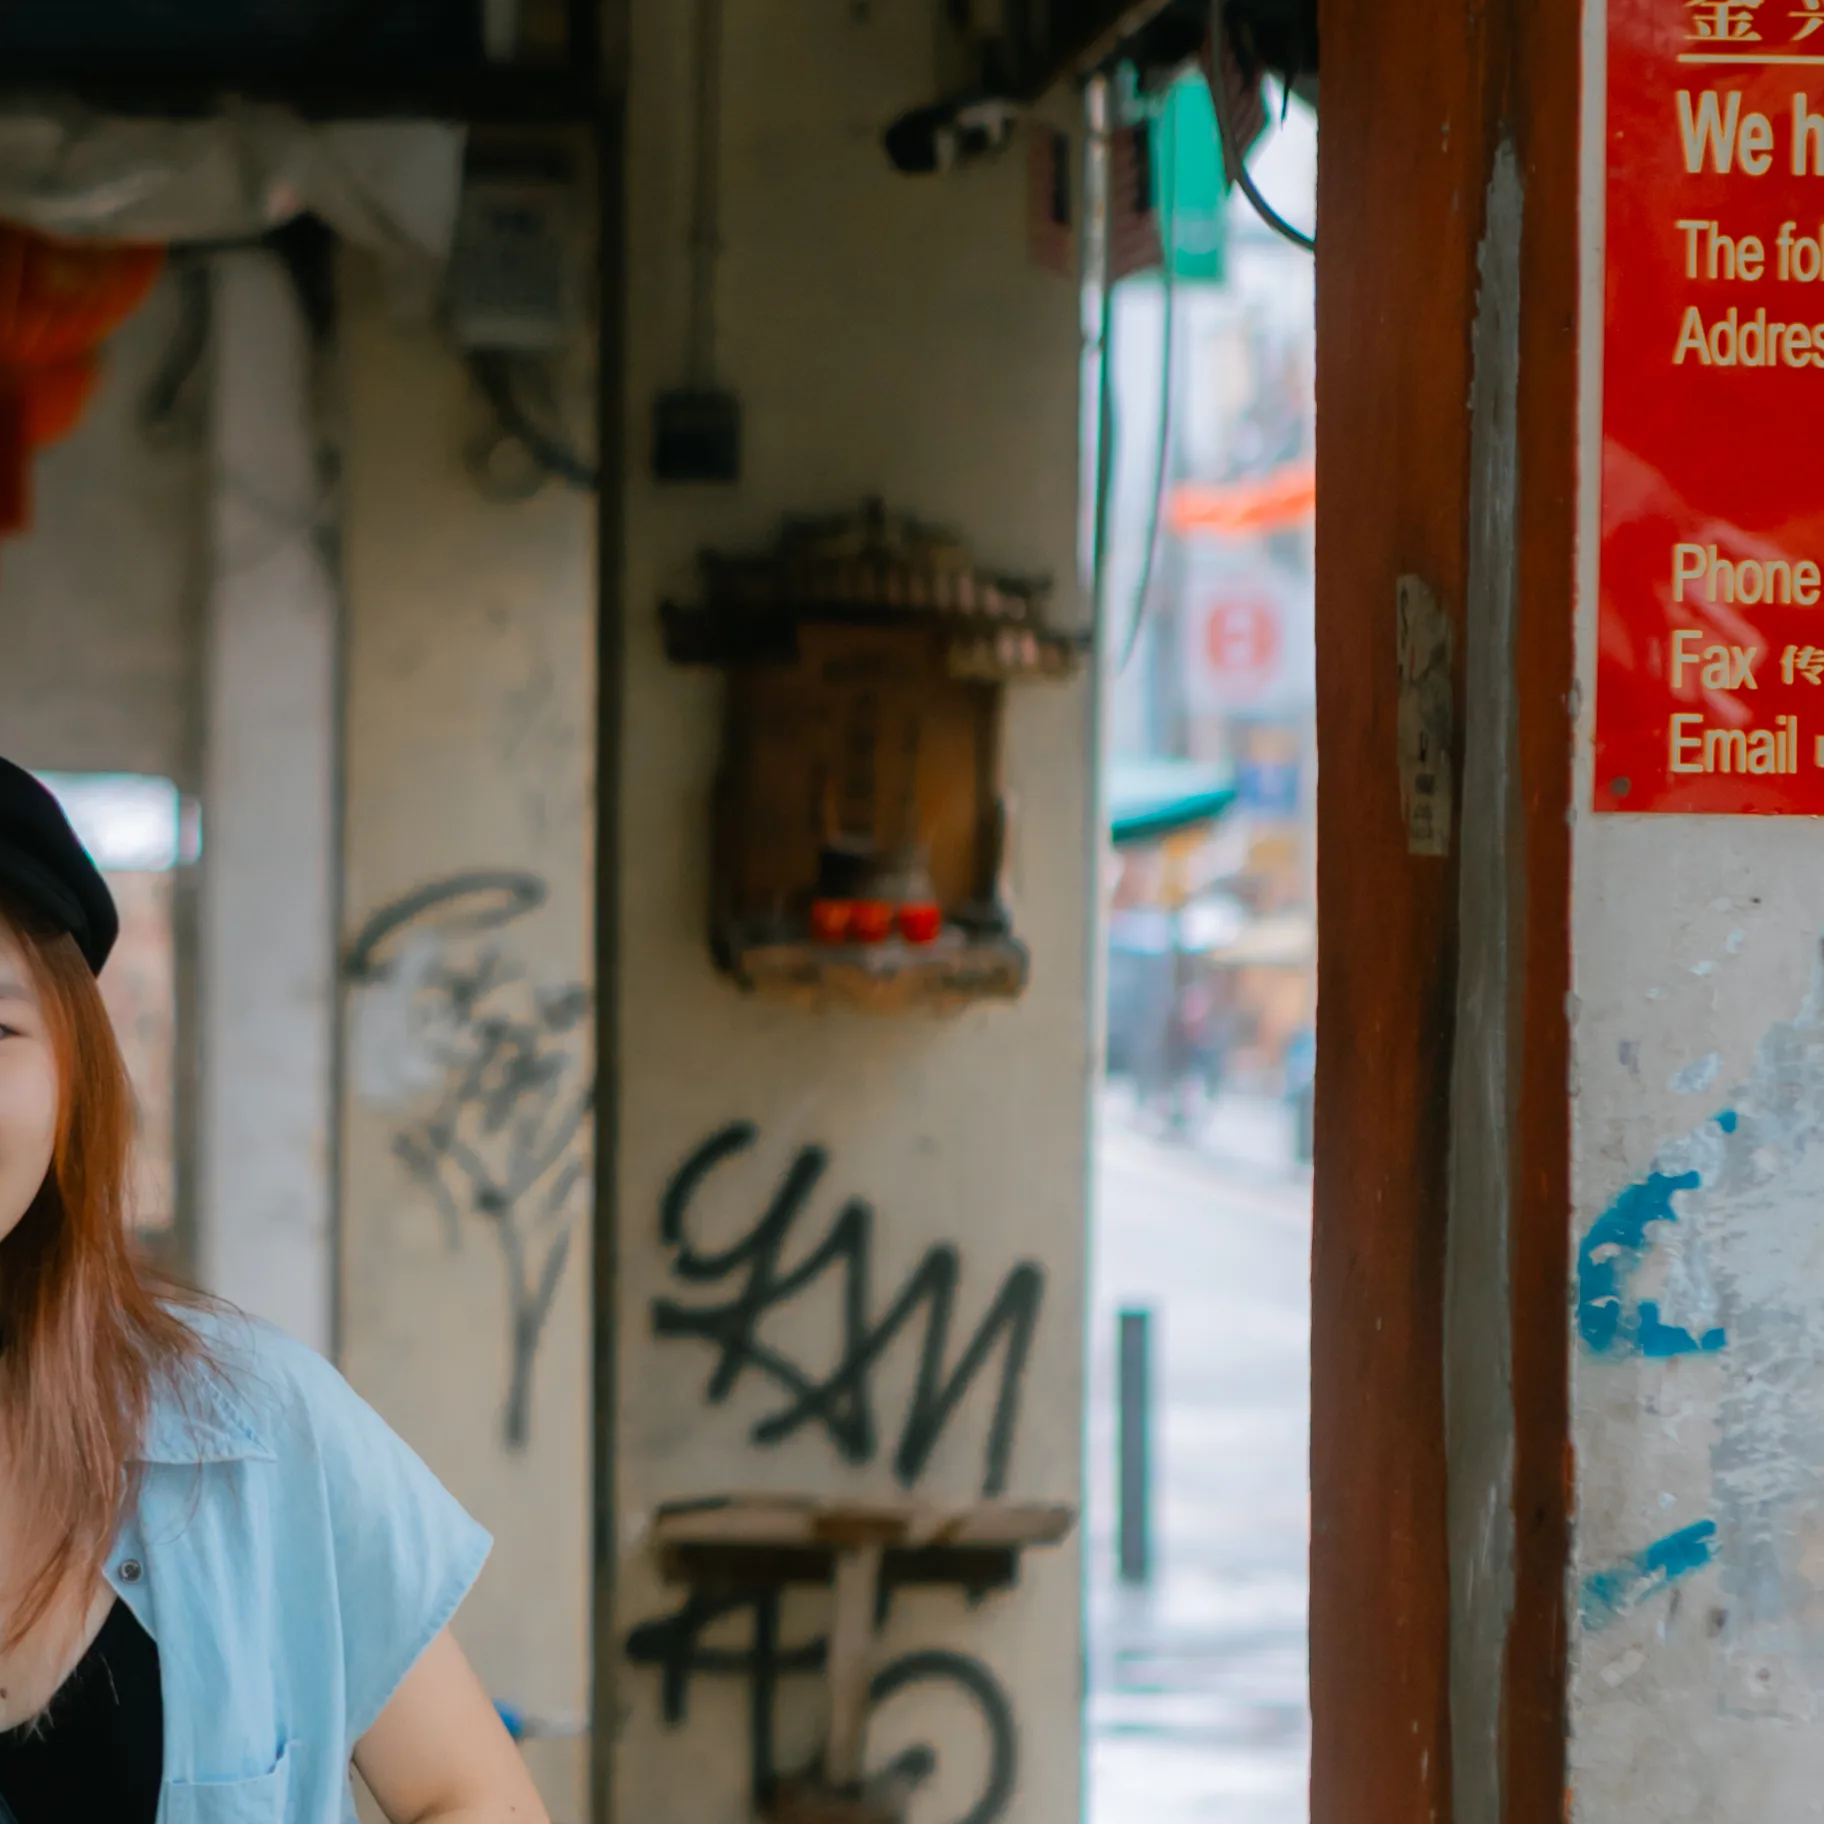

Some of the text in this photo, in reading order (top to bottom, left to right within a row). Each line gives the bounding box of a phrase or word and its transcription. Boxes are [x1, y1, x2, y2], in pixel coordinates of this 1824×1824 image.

[1676, 89, 1774, 177] We
[1675, 219, 1764, 281] The
[1672, 543, 1821, 606] Phone
[1671, 629, 1758, 690] Fax
[1669, 712, 1797, 775] Email
